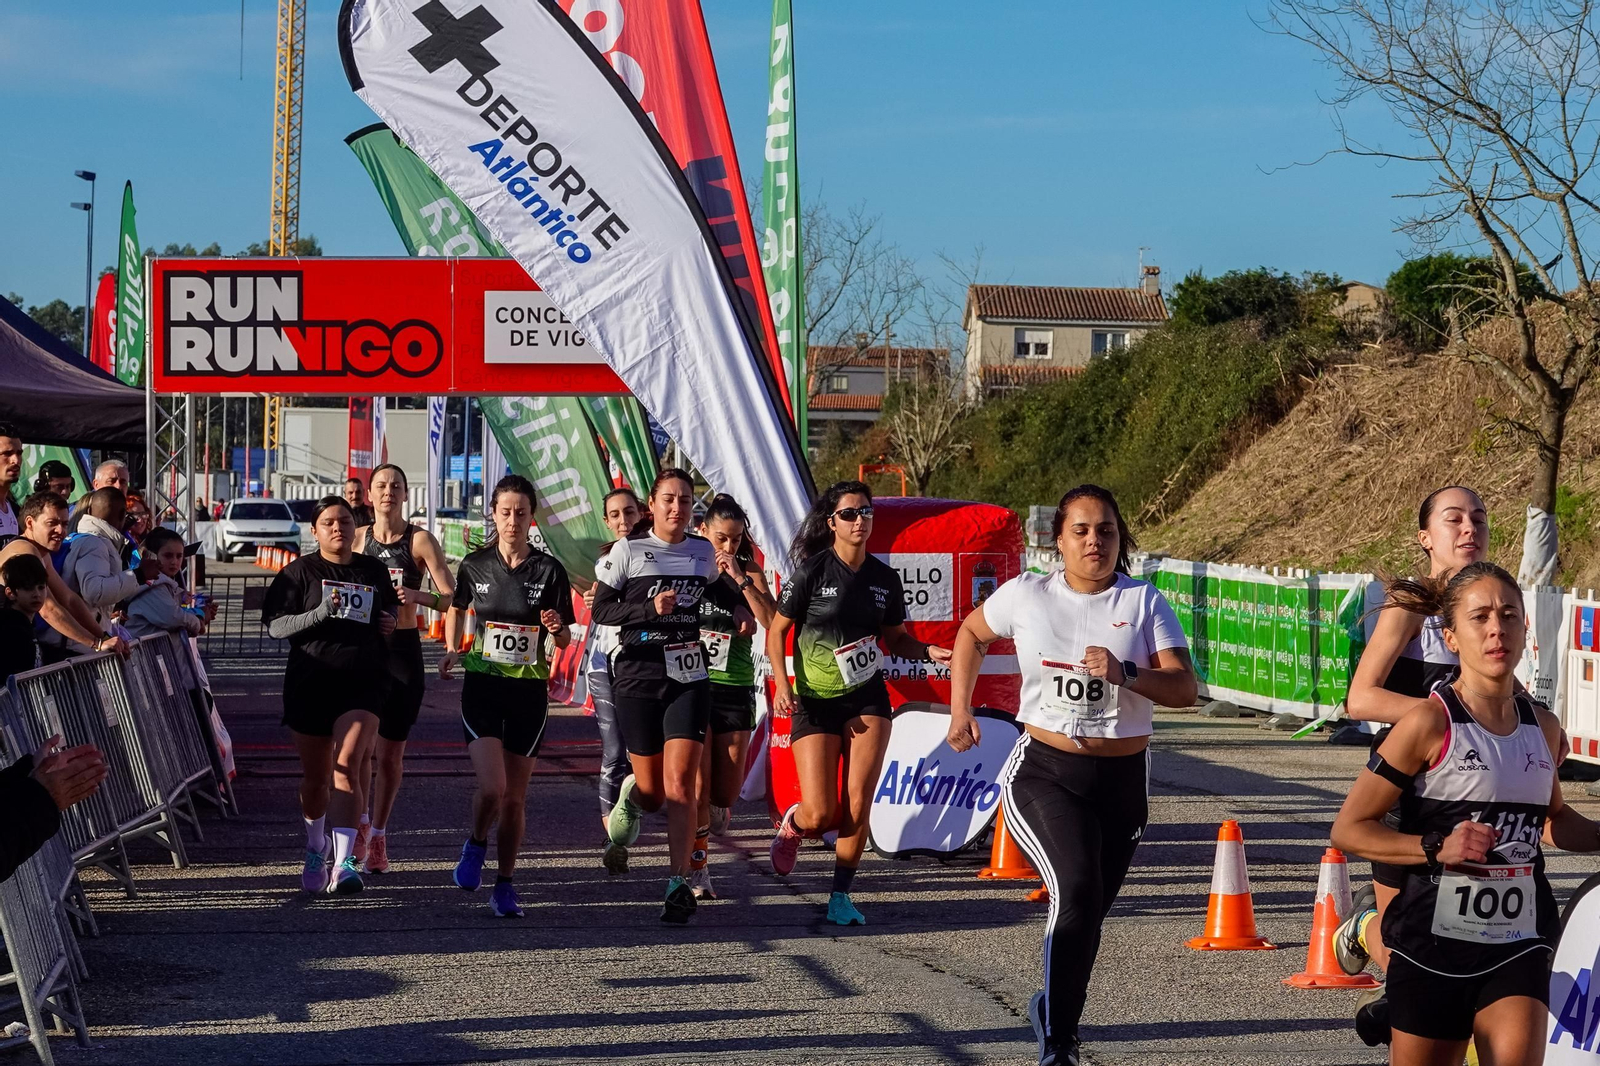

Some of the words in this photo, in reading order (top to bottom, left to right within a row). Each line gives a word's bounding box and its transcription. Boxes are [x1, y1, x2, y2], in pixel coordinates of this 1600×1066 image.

[456, 73, 629, 250] DEPORTE
[467, 138, 592, 264] Atlántico
[170, 276, 299, 322] RUN
[510, 329, 539, 347] DE
[493, 633, 530, 653] 103
[674, 652, 701, 672] 107
[846, 646, 877, 672] 106
[908, 665, 928, 681] de
[1052, 675, 1104, 702] 108
[873, 757, 1002, 812] Atlántico
[1454, 885, 1524, 920] 100
